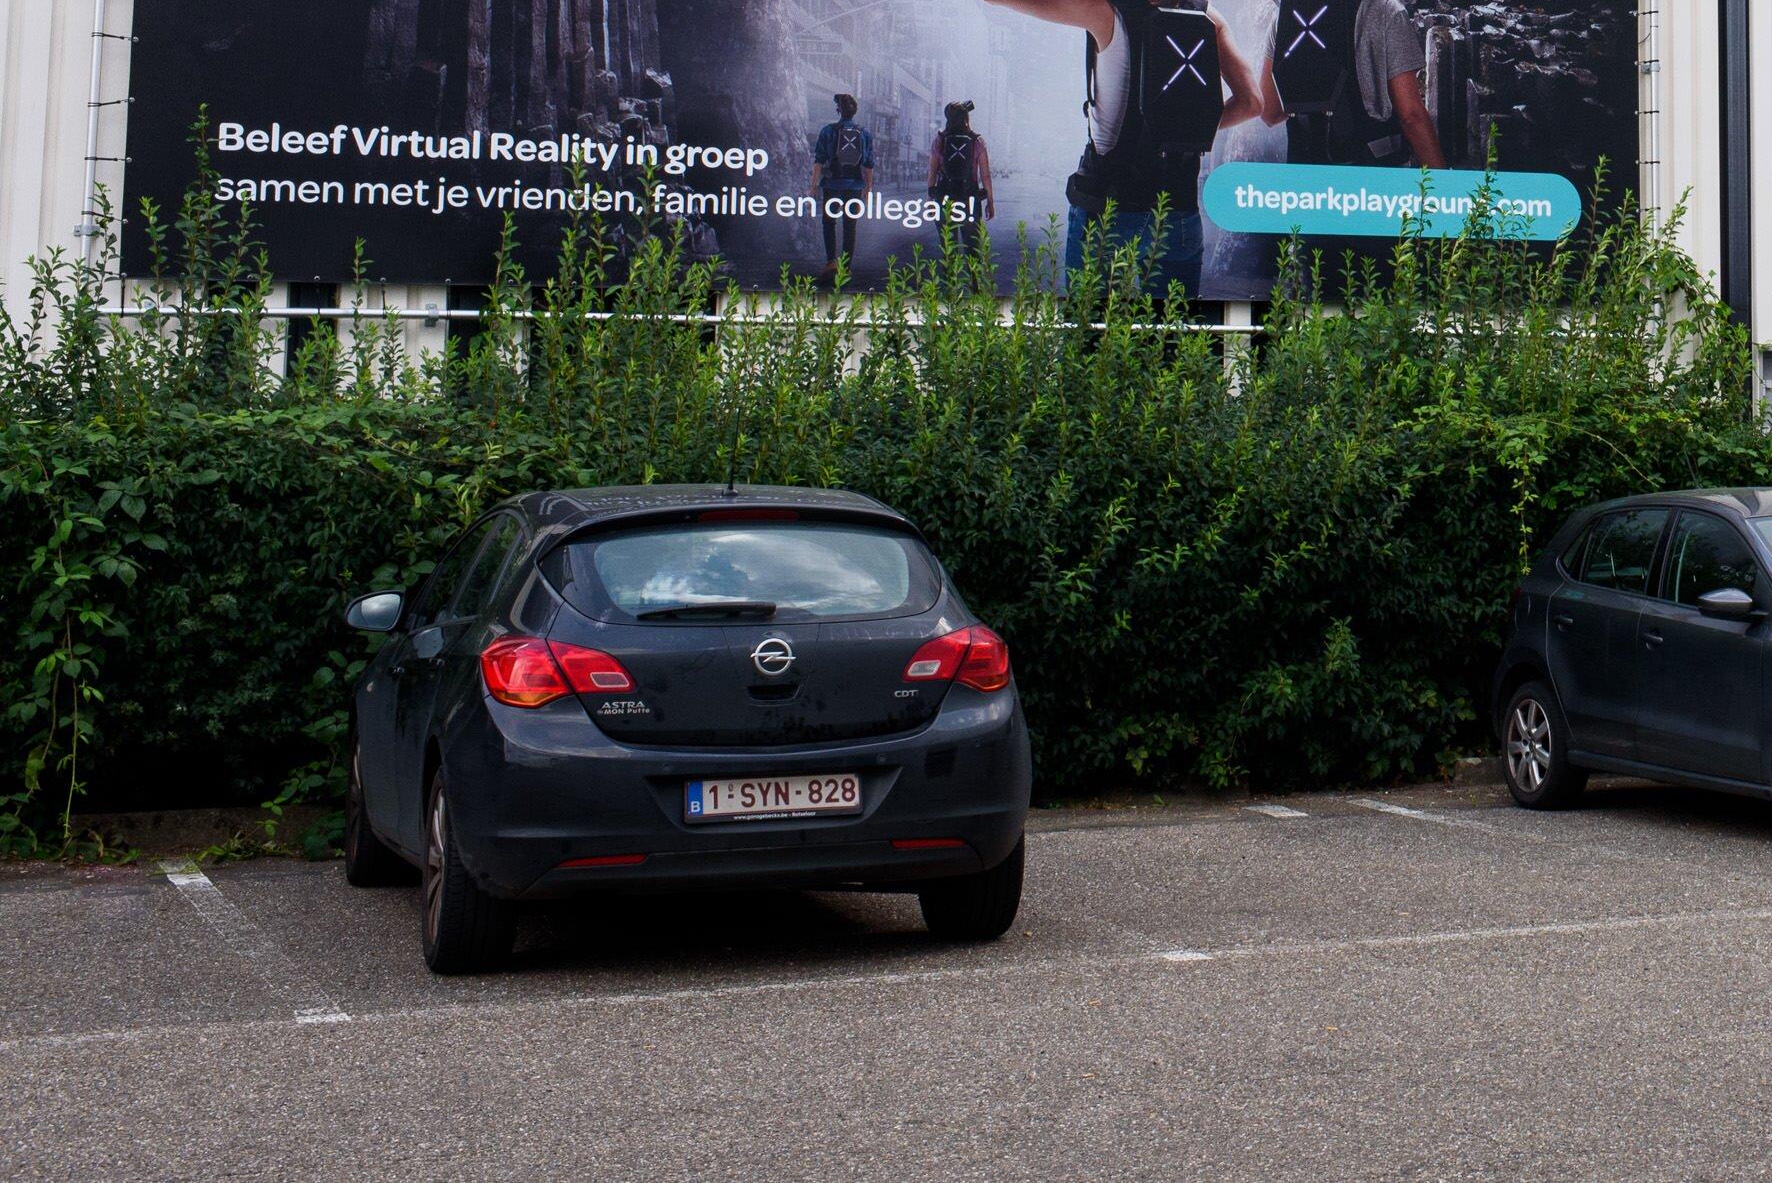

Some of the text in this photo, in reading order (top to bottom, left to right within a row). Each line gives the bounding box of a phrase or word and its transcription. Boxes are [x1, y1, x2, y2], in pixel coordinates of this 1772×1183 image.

[218, 122, 769, 176] Beleef Virtual Reality in groep
[214, 178, 344, 203] samen
[354, 179, 429, 206] met
[431, 176, 468, 214] je
[476, 179, 643, 215] vrienden,
[653, 184, 768, 216] familie
[776, 194, 817, 218] en
[1235, 183, 1552, 220] theparkplaygroun.com
[601, 700, 646, 709] ASTRA
[691, 801, 701, 813] B
[708, 777, 856, 810] 1-SYN-828
